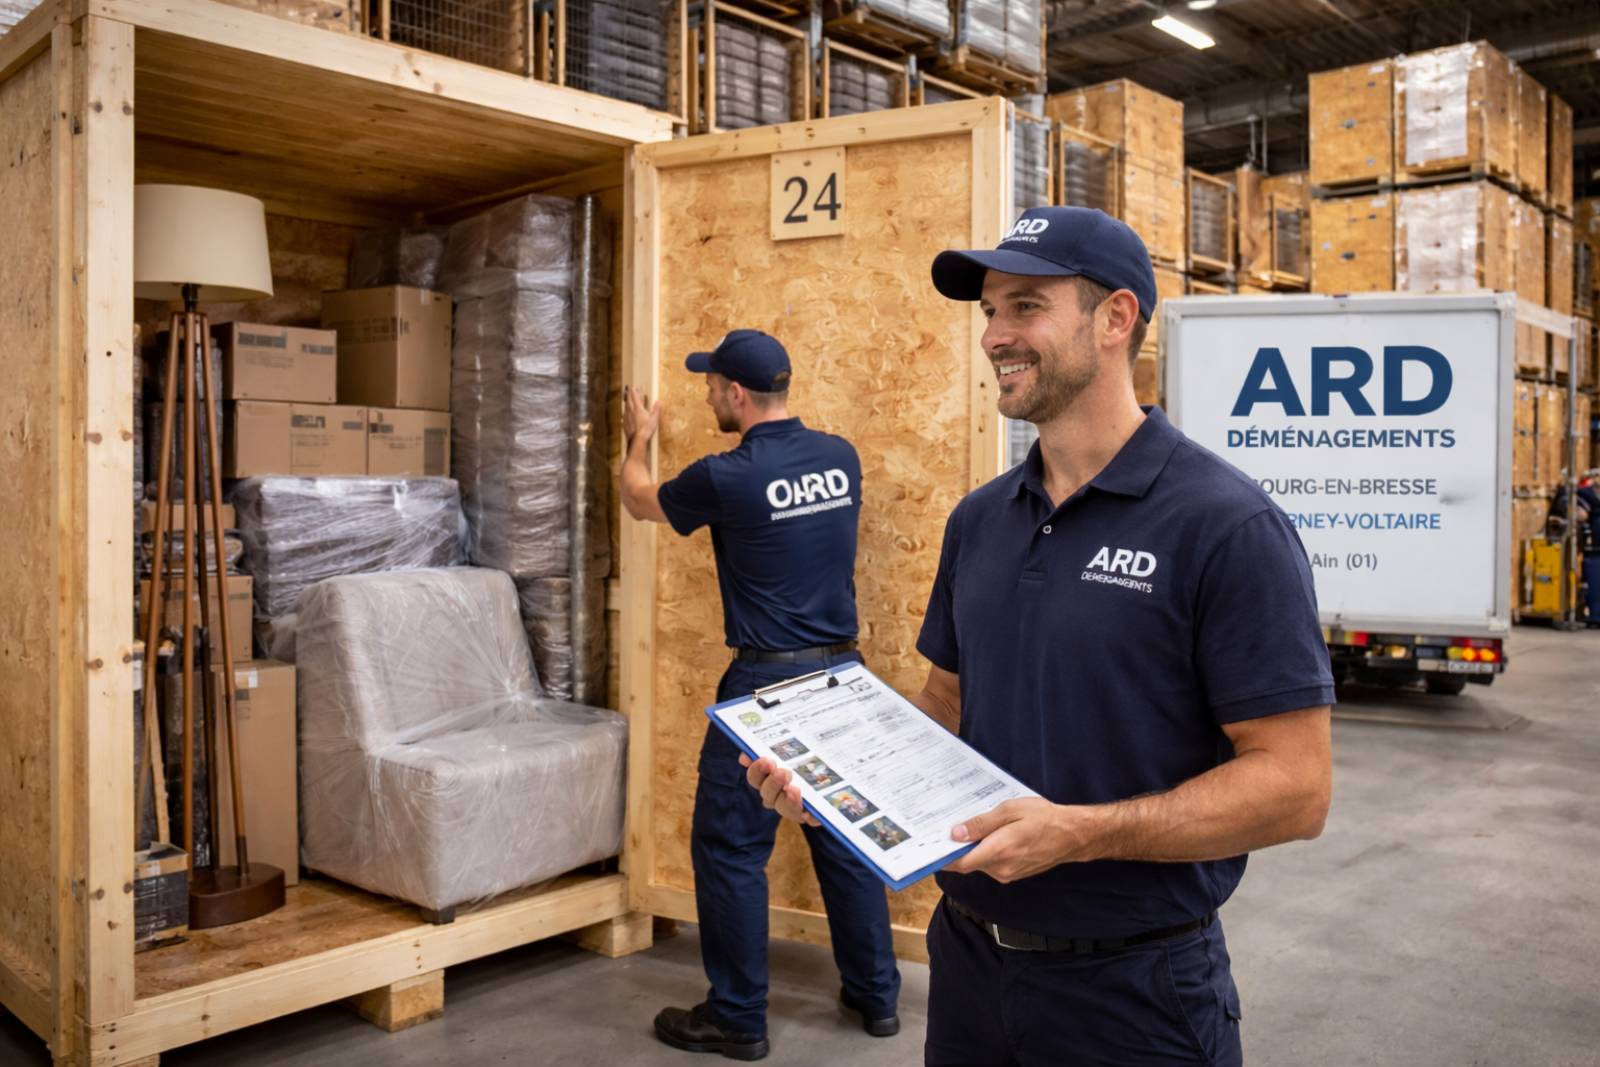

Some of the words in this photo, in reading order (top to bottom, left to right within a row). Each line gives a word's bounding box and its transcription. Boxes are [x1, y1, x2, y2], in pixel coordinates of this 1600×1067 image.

[783, 172, 842, 224] 24
[1230, 345, 1453, 417] ARD
[1227, 425, 1456, 448] DÉMÉNAGEMENTS
[1254, 478, 1437, 496] OURG-EN-BRESSE
[1086, 546, 1157, 577] ARD
[1311, 553, 1338, 568] Ain
[1347, 552, 1377, 571] (01)
